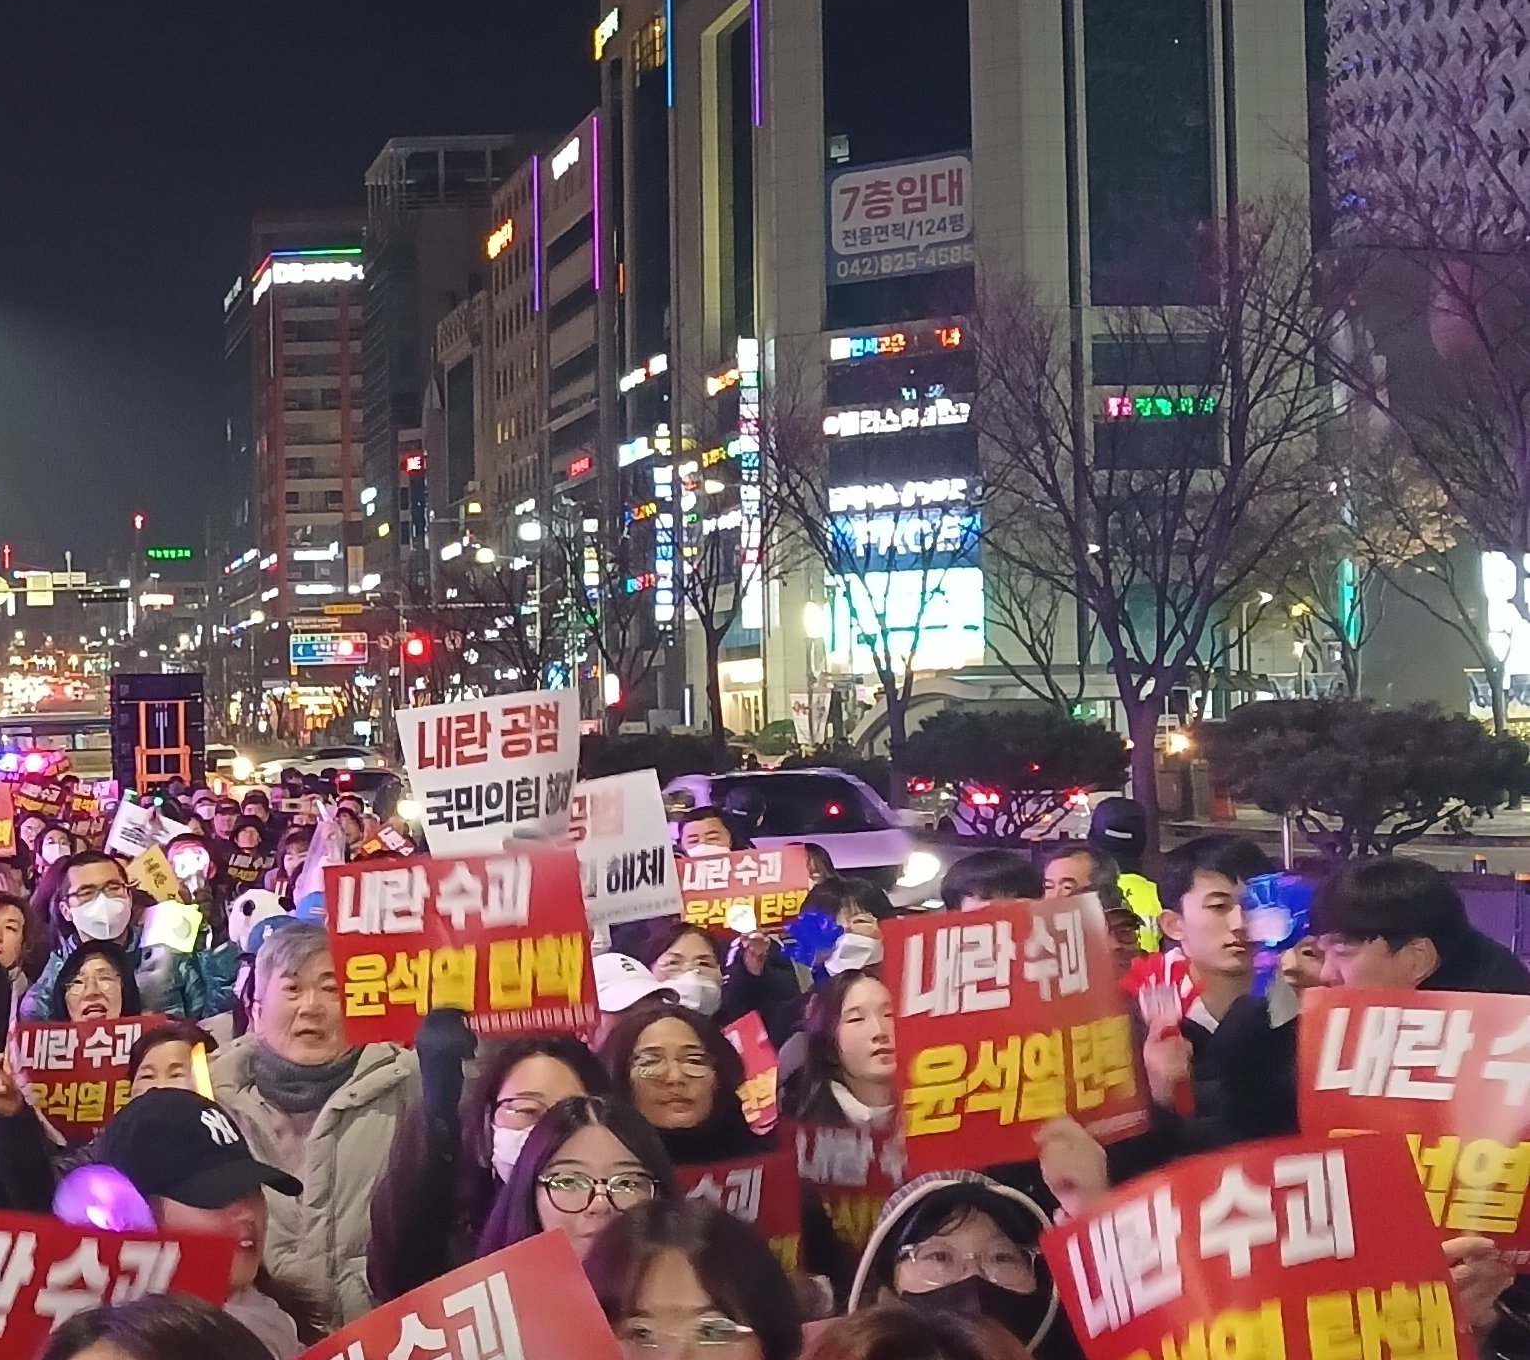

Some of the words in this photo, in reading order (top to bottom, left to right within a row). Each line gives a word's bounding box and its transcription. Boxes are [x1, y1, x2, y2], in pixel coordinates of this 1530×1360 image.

[840, 168, 963, 222] 7층임대
[417, 709, 492, 771] 내란
[500, 700, 562, 759] 공범
[425, 777, 541, 832] 국민의힘
[338, 861, 431, 937] 내란
[436, 854, 533, 933] 수괴
[606, 844, 666, 894] 해체
[683, 857, 733, 891] 내란
[735, 852, 783, 886] 수괴
[346, 944, 478, 1019] 윤석열
[488, 931, 585, 1011] 탄핵
[902, 918, 1017, 1018] 내란
[1023, 910, 1089, 1002] 수괴
[22, 1029, 79, 1071] 내란
[903, 1031, 1067, 1138] 윤석열
[1316, 1006, 1473, 1103] 내란
[1070, 1186, 1184, 1340] 내란
[1197, 1148, 1358, 1280] 수괴
